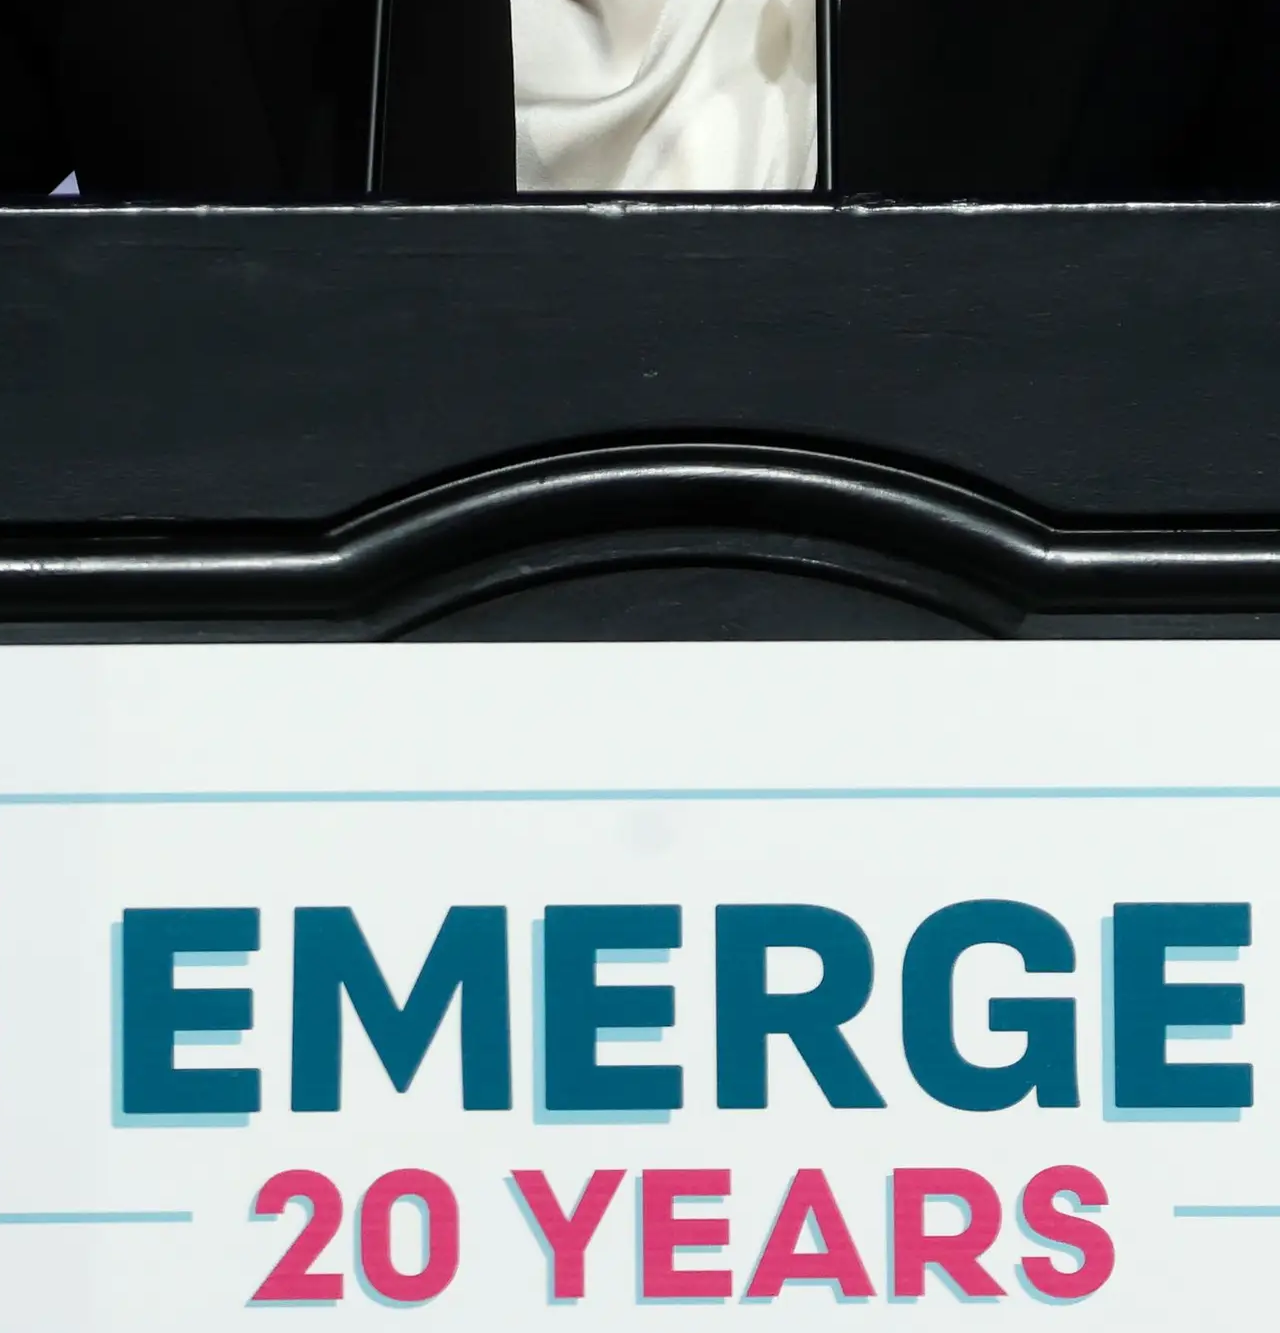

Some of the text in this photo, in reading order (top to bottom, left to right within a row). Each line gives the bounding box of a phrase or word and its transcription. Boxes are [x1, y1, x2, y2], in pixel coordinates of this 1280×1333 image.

[110, 898, 1255, 1128] EMERGE
[244, 1163, 1118, 1308] 20 YEARS
